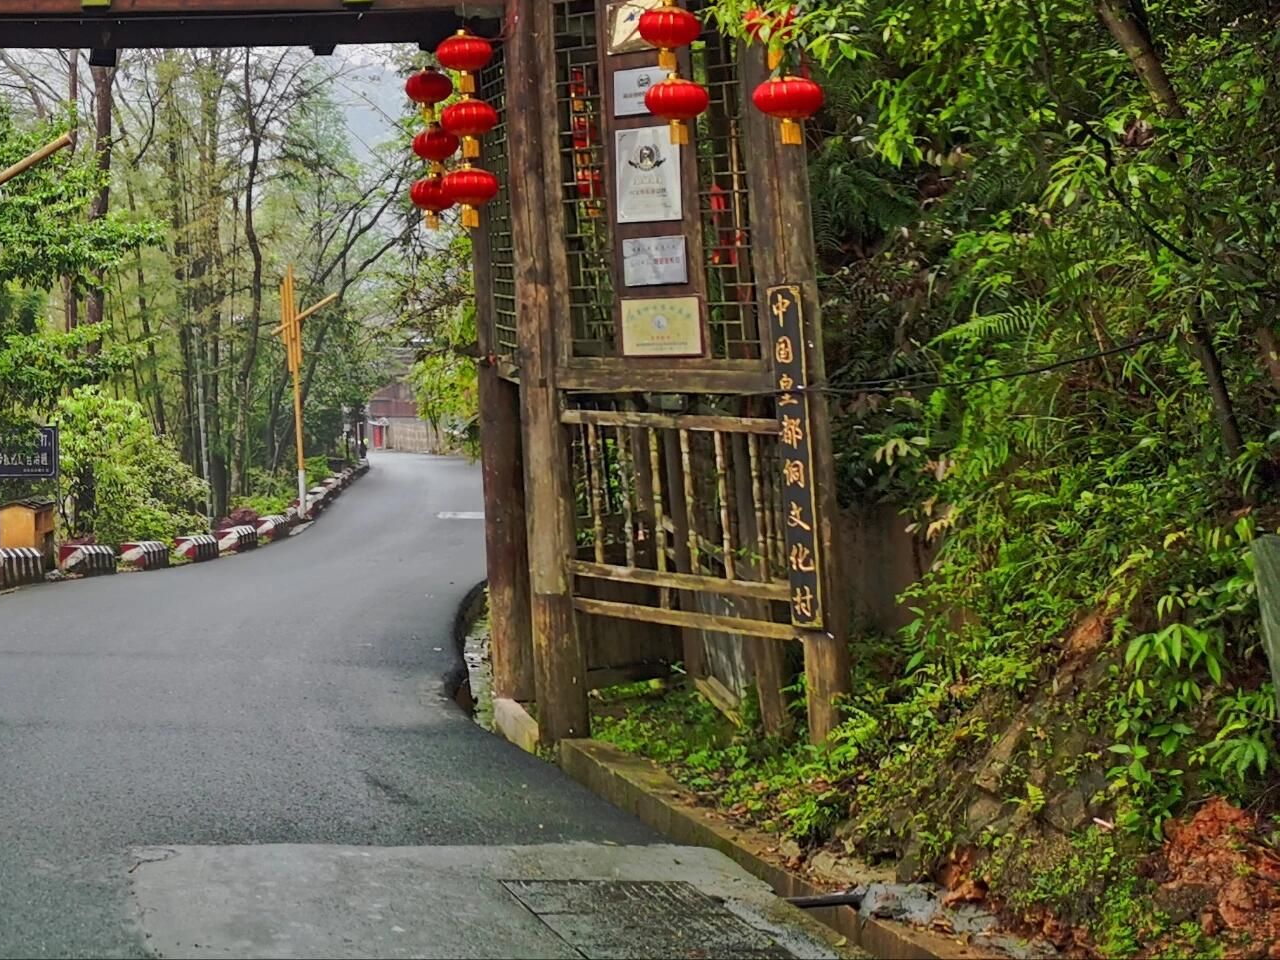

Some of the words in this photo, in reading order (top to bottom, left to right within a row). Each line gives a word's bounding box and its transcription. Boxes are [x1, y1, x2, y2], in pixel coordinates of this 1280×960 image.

[771, 293, 815, 617] 中国皇都侗文化村
